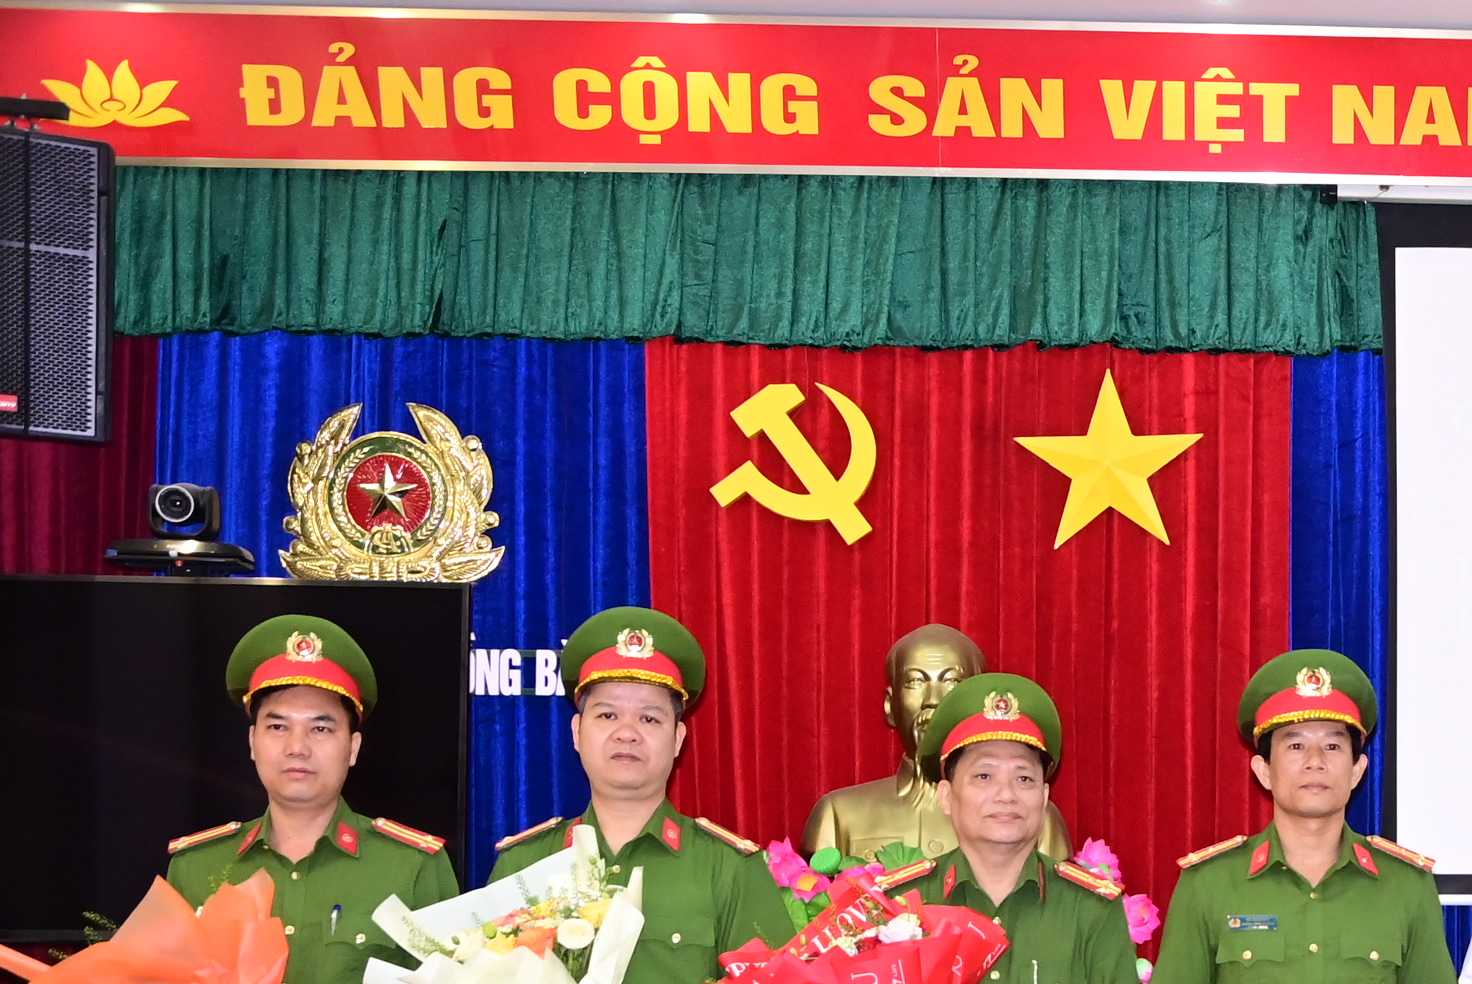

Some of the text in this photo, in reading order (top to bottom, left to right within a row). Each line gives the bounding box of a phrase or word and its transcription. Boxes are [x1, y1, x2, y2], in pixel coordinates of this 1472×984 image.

[240, 42, 514, 129] ĐẢNG
[553, 56, 819, 146] CỘNG
[869, 54, 1064, 139] SẢN
[1099, 67, 1300, 154] VIỆT
